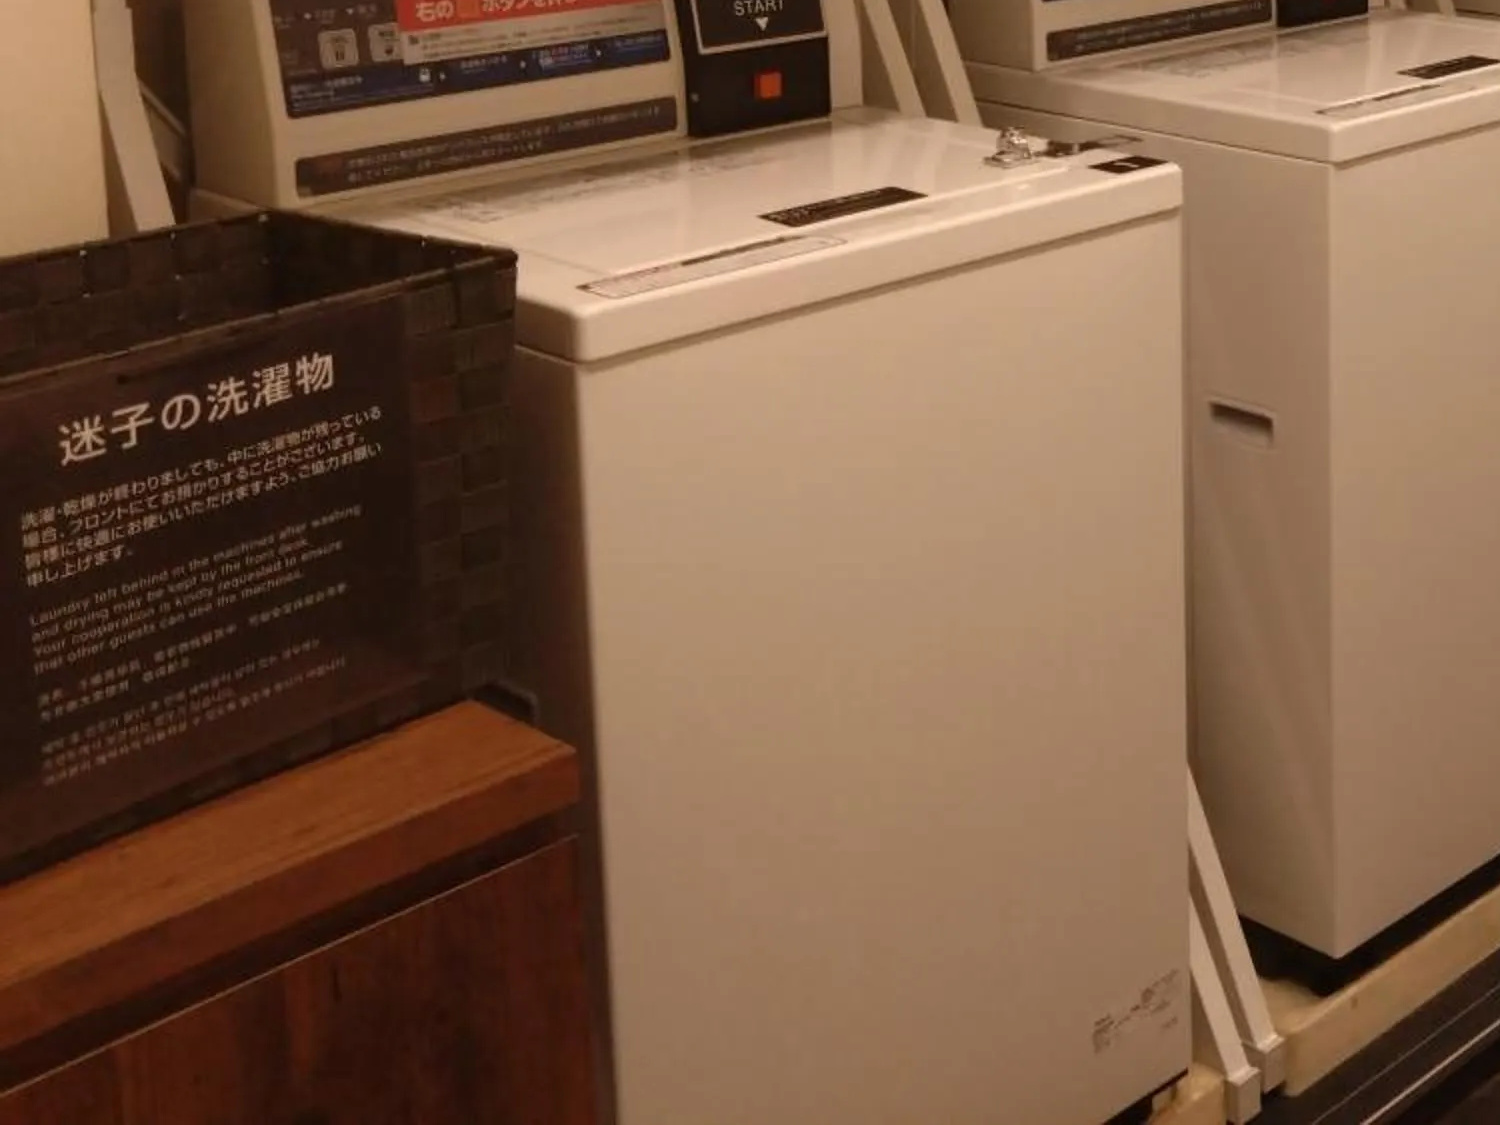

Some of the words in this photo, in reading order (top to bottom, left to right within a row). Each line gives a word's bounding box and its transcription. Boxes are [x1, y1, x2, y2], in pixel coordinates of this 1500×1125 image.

[58, 351, 335, 467] 迷子の洗濯物
[30, 597, 91, 626] Laundry
[121, 569, 168, 595] behind
[188, 556, 210, 573] the
[213, 534, 275, 563] machines
[311, 504, 363, 528] washing
[32, 623, 59, 643] and
[62, 607, 110, 633] drying
[112, 596, 142, 615] may
[147, 587, 164, 602] be
[167, 576, 198, 595] kept
[201, 569, 217, 583] by
[221, 559, 241, 575] the
[34, 639, 66, 658] Your
[71, 606, 155, 645] cooperation
[175, 586, 215, 608] kindly
[217, 560, 282, 592] requested
[301, 539, 343, 562] ensure
[34, 656, 63, 676] that
[67, 641, 105, 663] other
[109, 623, 156, 651] guests
[159, 613, 186, 629] can
[188, 601, 213, 619] use
[217, 592, 237, 608] the
